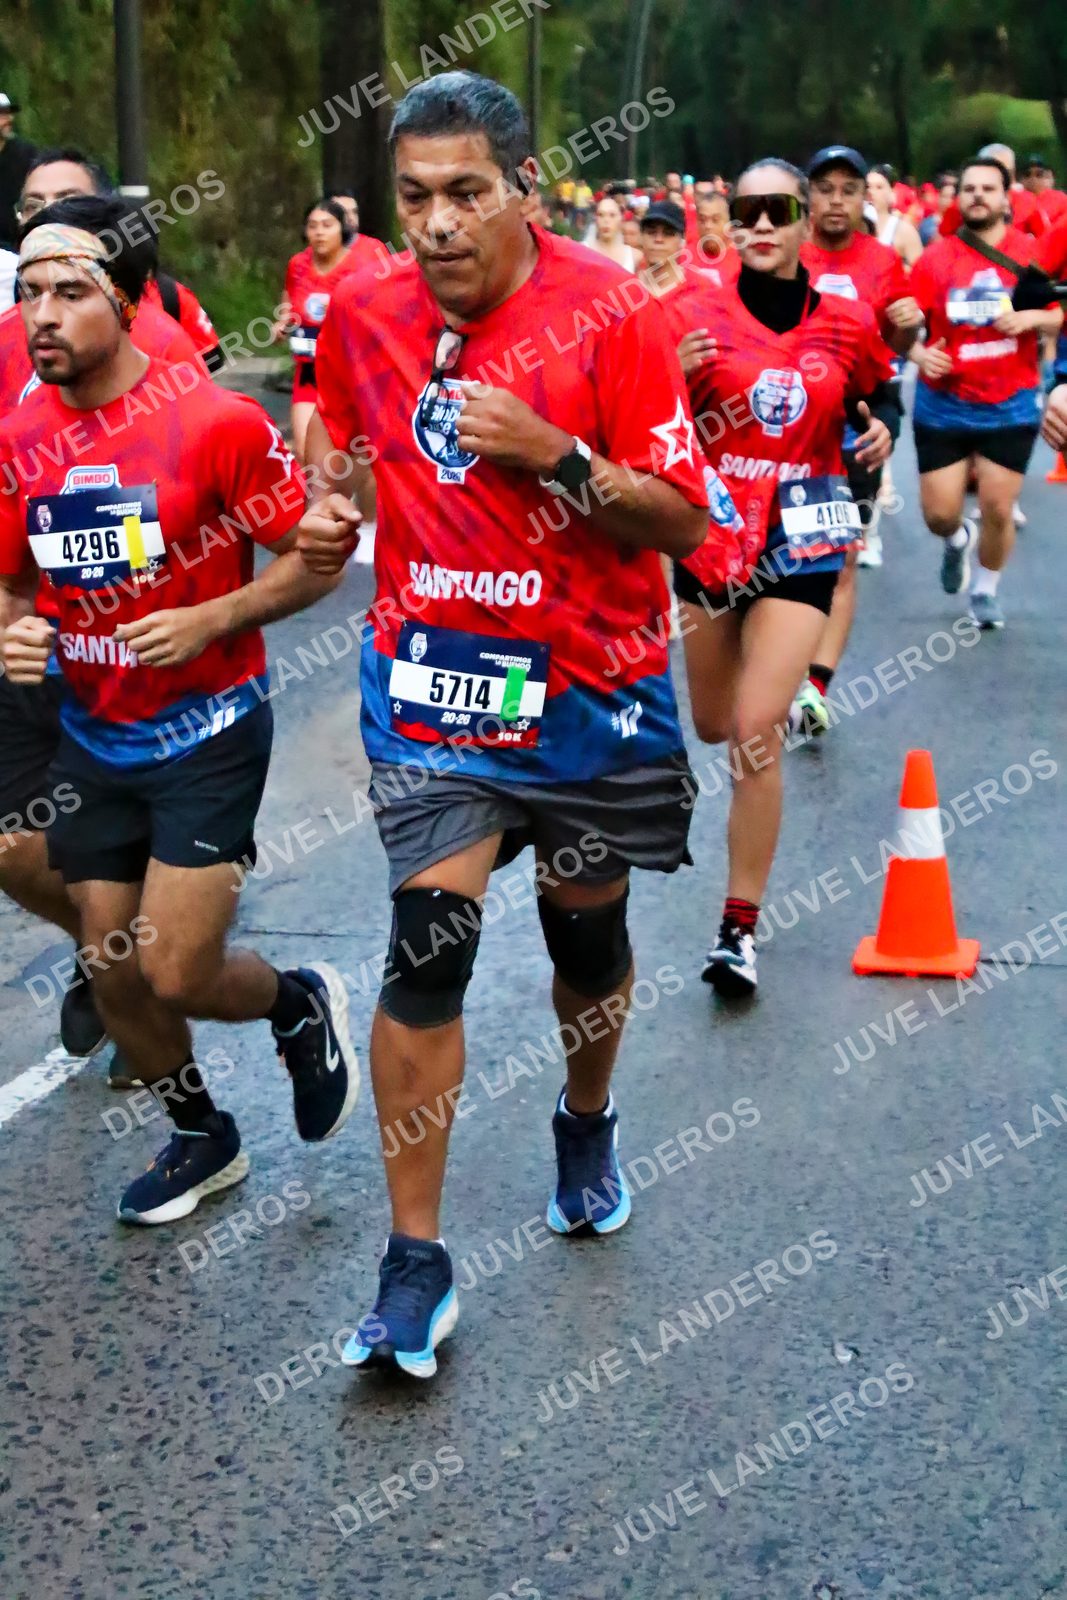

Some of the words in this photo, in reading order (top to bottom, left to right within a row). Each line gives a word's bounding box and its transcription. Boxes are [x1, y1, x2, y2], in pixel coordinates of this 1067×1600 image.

[73, 473, 111, 485] BIMBO
[62, 530, 120, 563] 4296
[409, 560, 543, 607] SANTIAGO
[429, 671, 491, 709] 5714
[440, 711, 471, 725] 20-26
[497, 732, 523, 742] 10K
